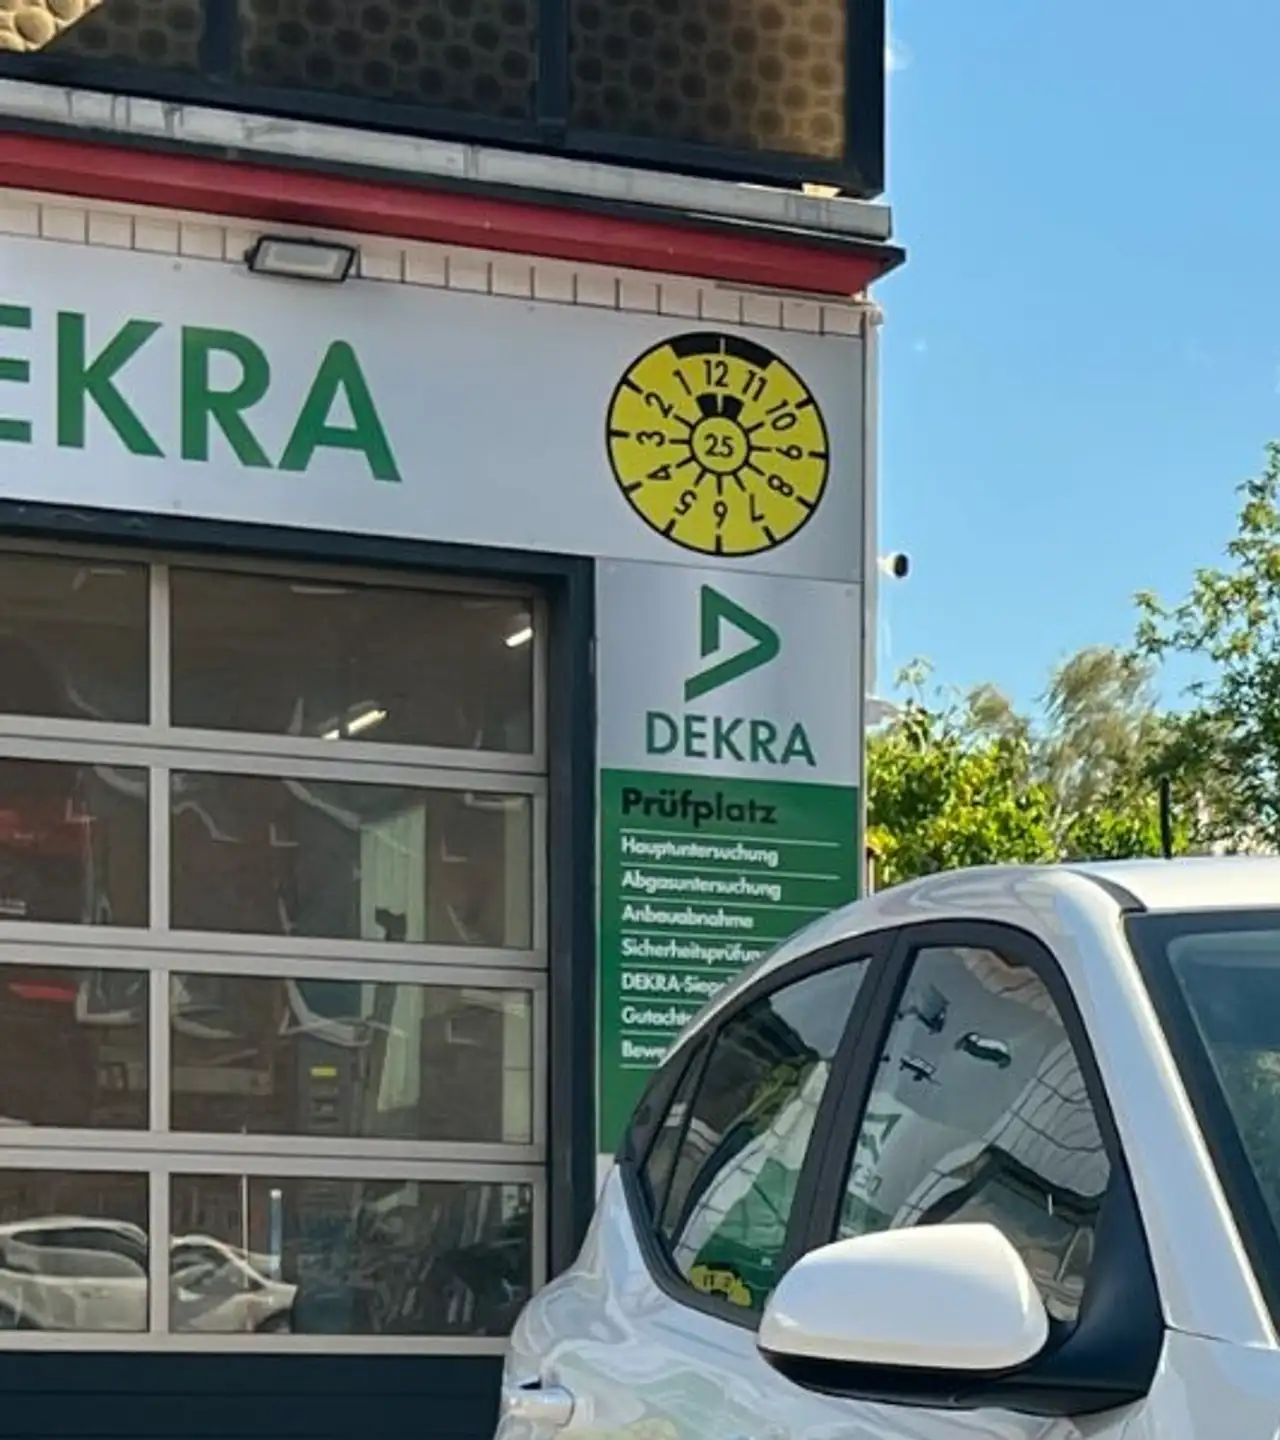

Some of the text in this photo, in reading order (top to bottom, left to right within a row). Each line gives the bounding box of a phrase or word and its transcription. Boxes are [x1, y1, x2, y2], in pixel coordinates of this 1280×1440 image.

[672, 369, 692, 396] 1
[703, 359, 729, 388] 12
[742, 370, 768, 401] 11
[0, 303, 402, 482] EKRA
[642, 391, 673, 418] 2
[765, 399, 797, 431] 10
[636, 430, 665, 447] 3
[703, 433, 734, 458] 25
[775, 444, 803, 460] 9
[647, 463, 671, 481] 4
[767, 473, 794, 498] 8
[673, 489, 697, 516] 5
[712, 500, 728, 528] 6
[749, 493, 765, 522] 7
[645, 710, 817, 768] DEKRA
[621, 787, 778, 828] Prüfplatz
[621, 836, 779, 867] Hauptuntersuchung
[621, 870, 781, 901] Abgasuntersuchung
[621, 904, 754, 929] Anbauabnahme
[621, 937, 766, 965] Sicherheitsprüfun
